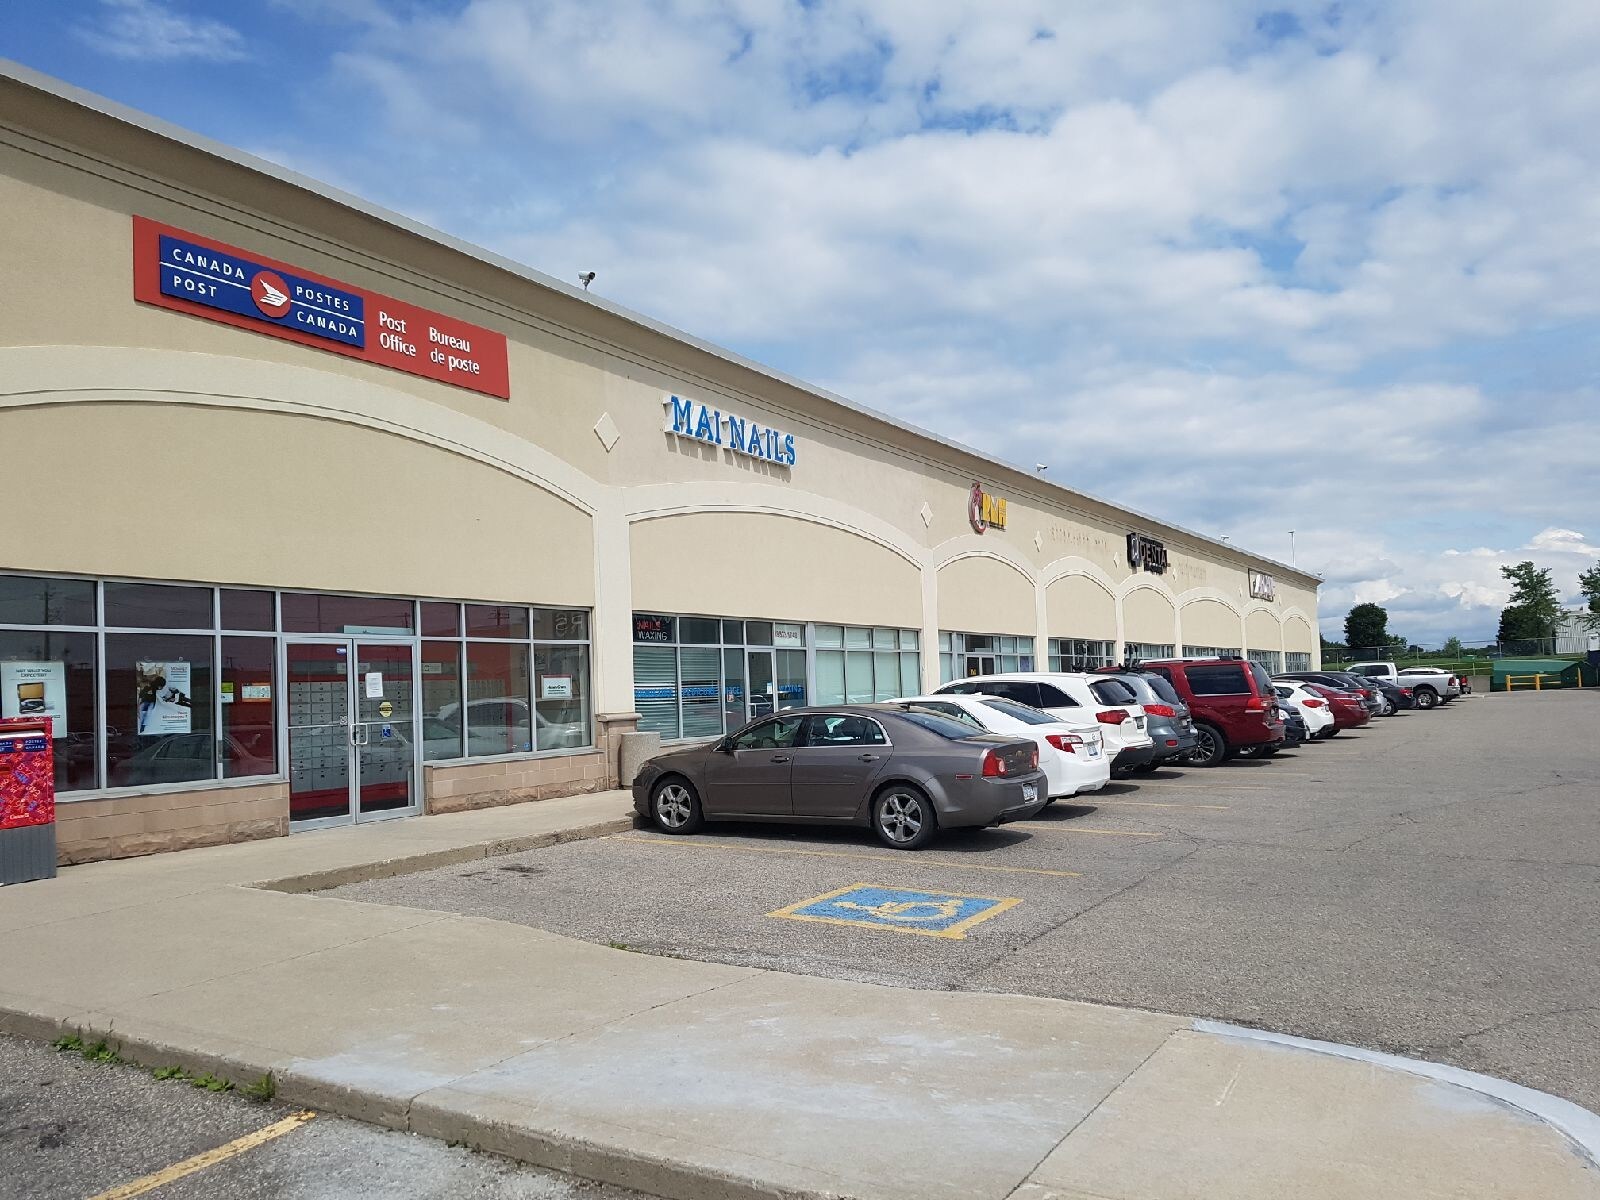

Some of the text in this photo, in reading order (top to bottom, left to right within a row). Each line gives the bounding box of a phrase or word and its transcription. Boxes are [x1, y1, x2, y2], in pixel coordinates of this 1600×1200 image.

[172, 248, 246, 280] CANADA
[173, 275, 218, 298] POST
[296, 285, 351, 312] POSTES
[296, 310, 358, 339] CANADA
[379, 311, 407, 335] Post
[379, 333, 417, 358] Office
[428, 326, 471, 354] Bureau
[430, 347, 481, 376] de poste
[670, 394, 797, 467] MAI NAILS
[638, 630, 668, 641] WAXING
